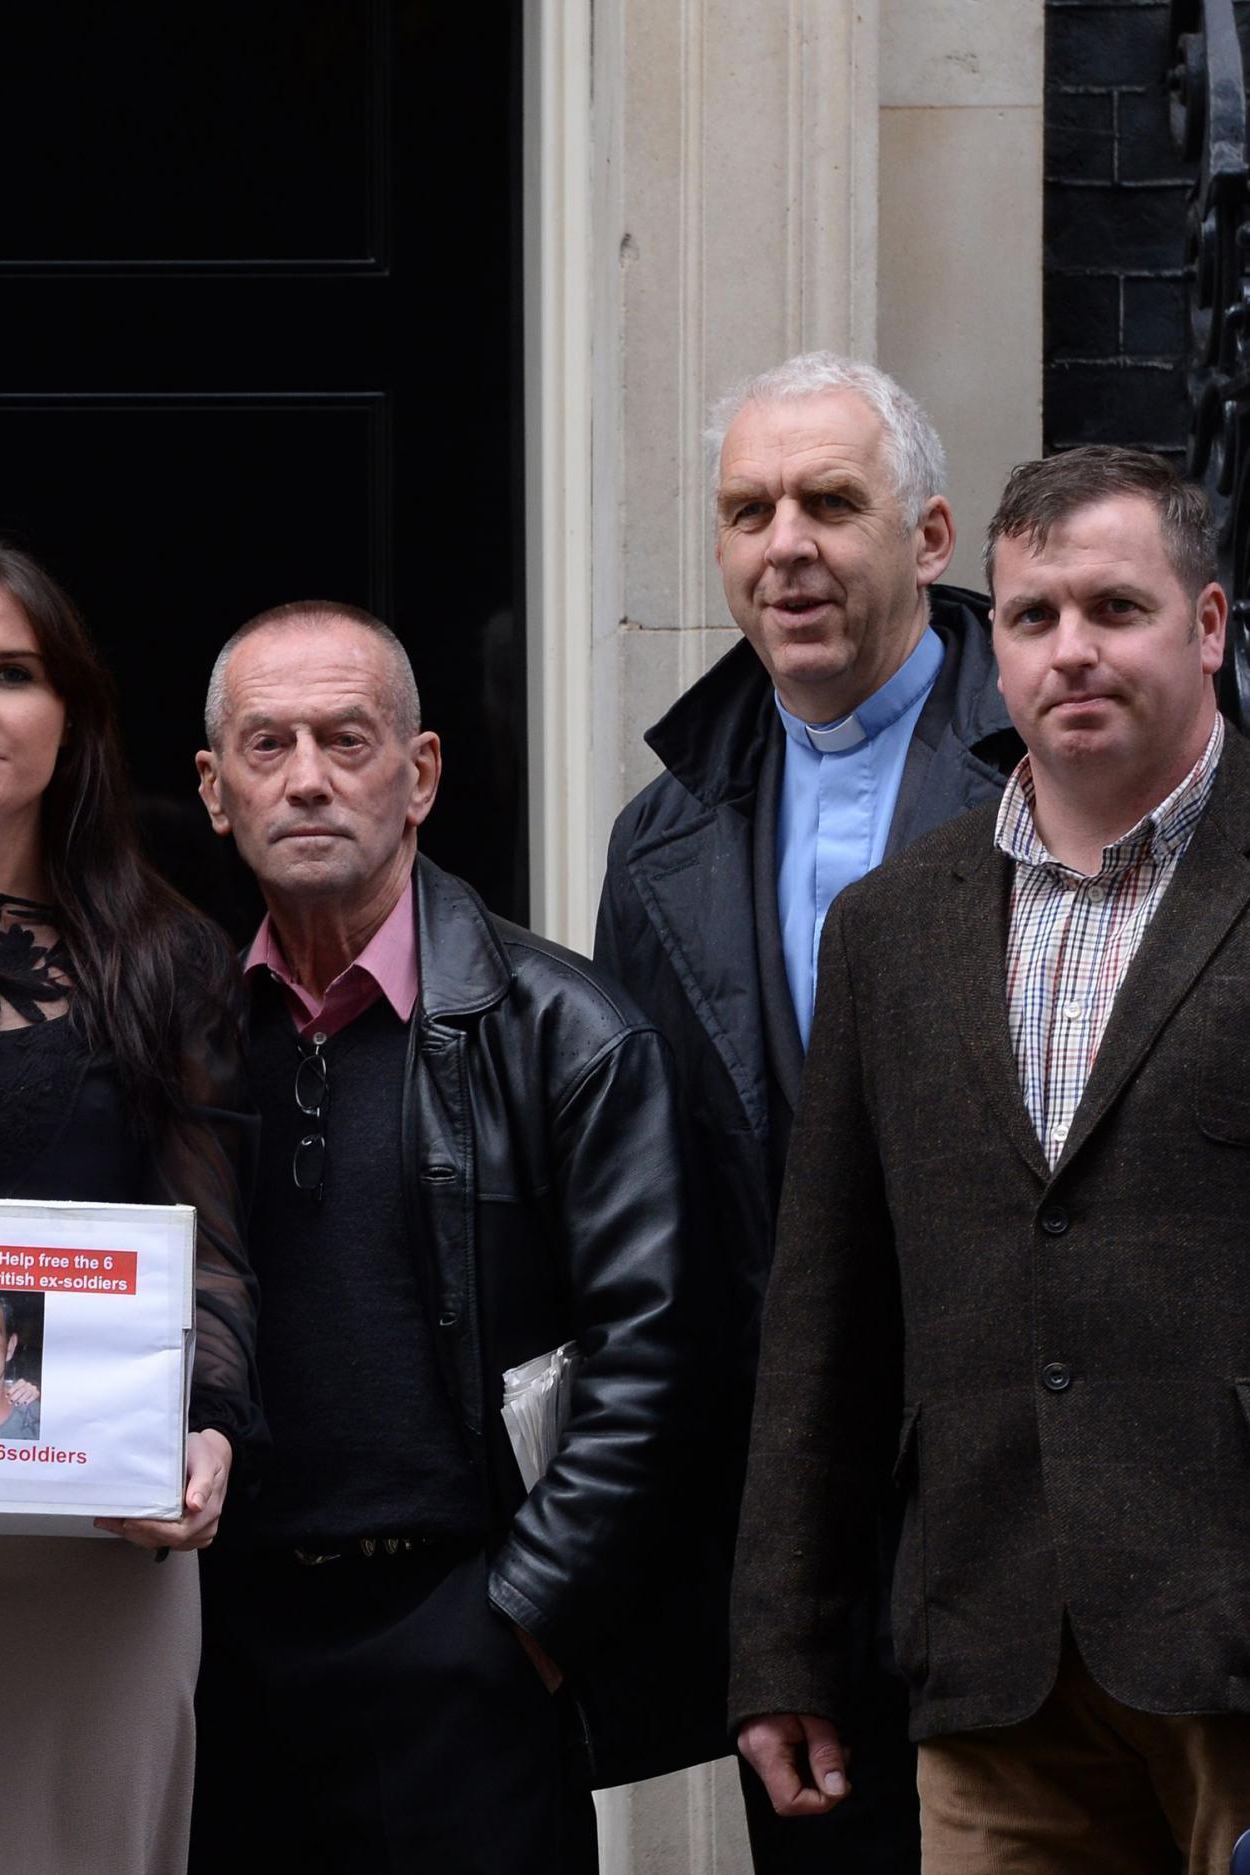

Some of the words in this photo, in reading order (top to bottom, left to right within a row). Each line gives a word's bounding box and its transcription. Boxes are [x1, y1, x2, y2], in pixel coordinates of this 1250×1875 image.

[38, 1253, 69, 1268] free
[74, 1255, 99, 1270] the
[103, 1256, 114, 1270] 6
[39, 1275, 128, 1291] ex-soldiers
